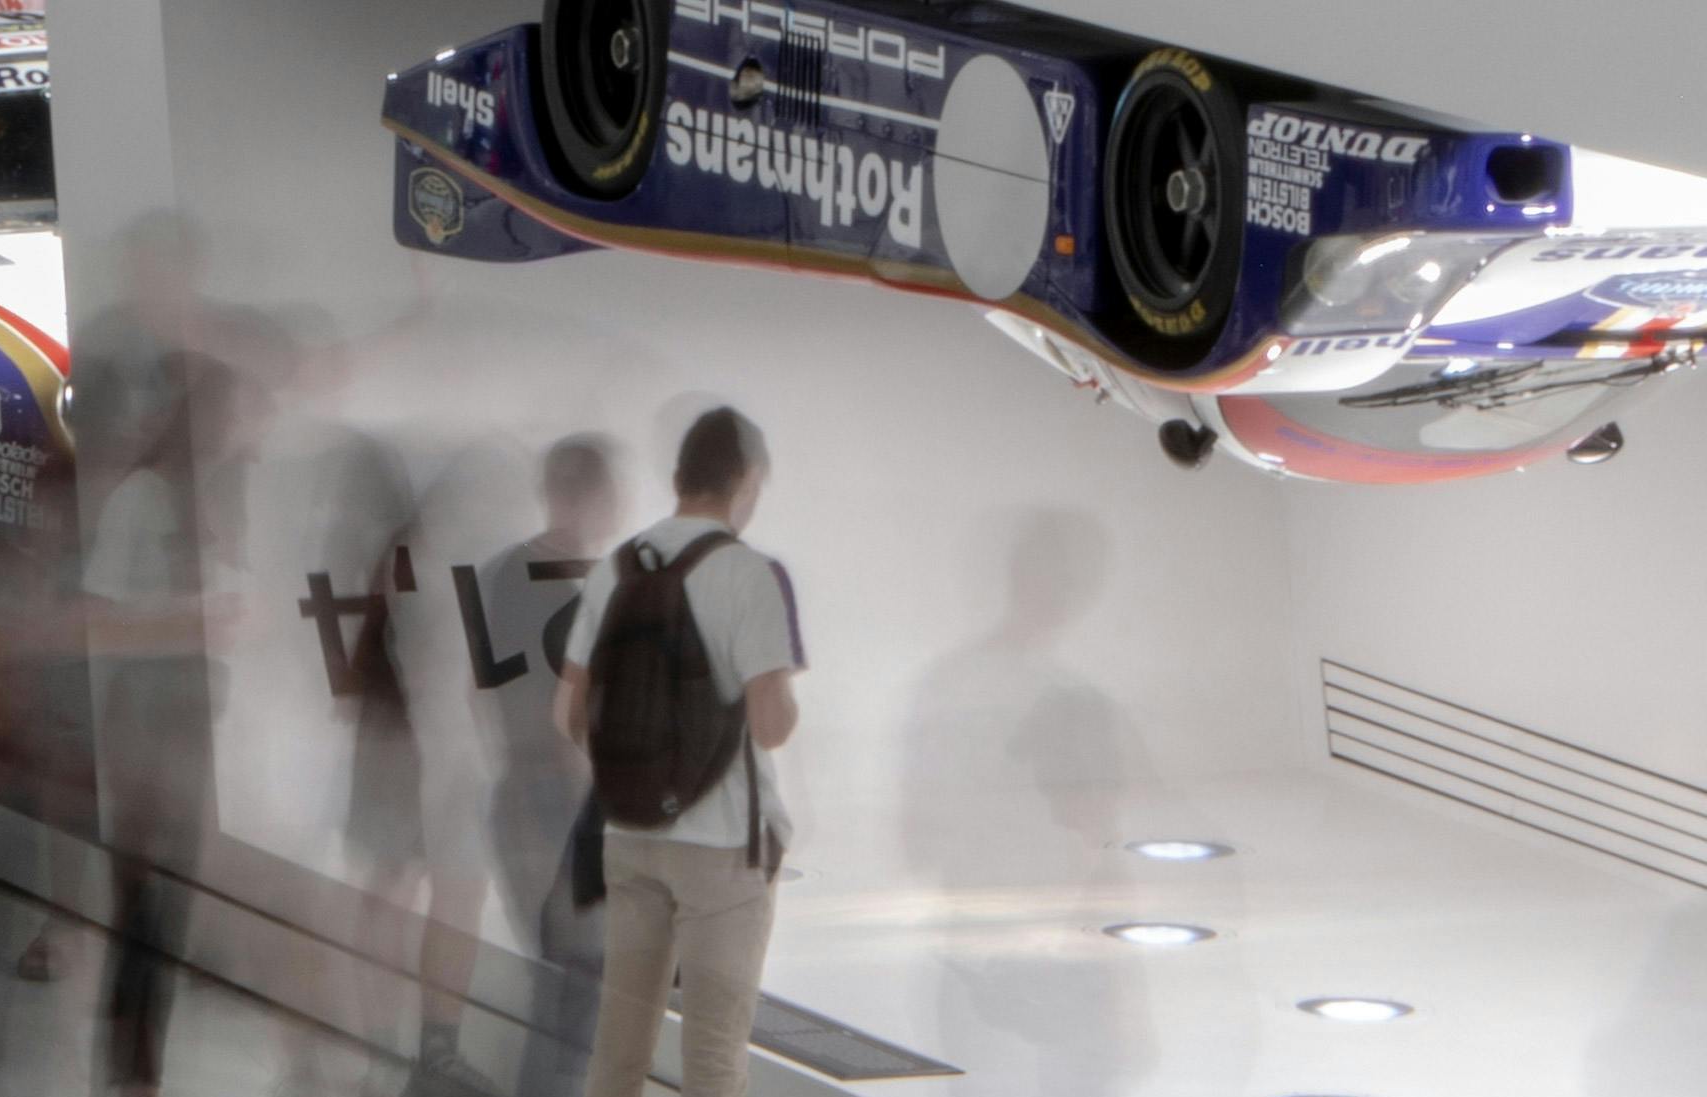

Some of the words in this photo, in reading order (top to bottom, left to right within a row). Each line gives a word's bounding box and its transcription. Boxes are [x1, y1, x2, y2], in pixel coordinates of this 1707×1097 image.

[675, 0, 945, 79] PORSCHE
[426, 71, 495, 129] Shell
[1246, 111, 1430, 165] DUNLOP
[1248, 137, 1331, 172] TELETRON
[665, 99, 923, 250] Rothmans
[1248, 177, 1310, 210] BILSTEIN
[1246, 199, 1310, 236] BOSCH
